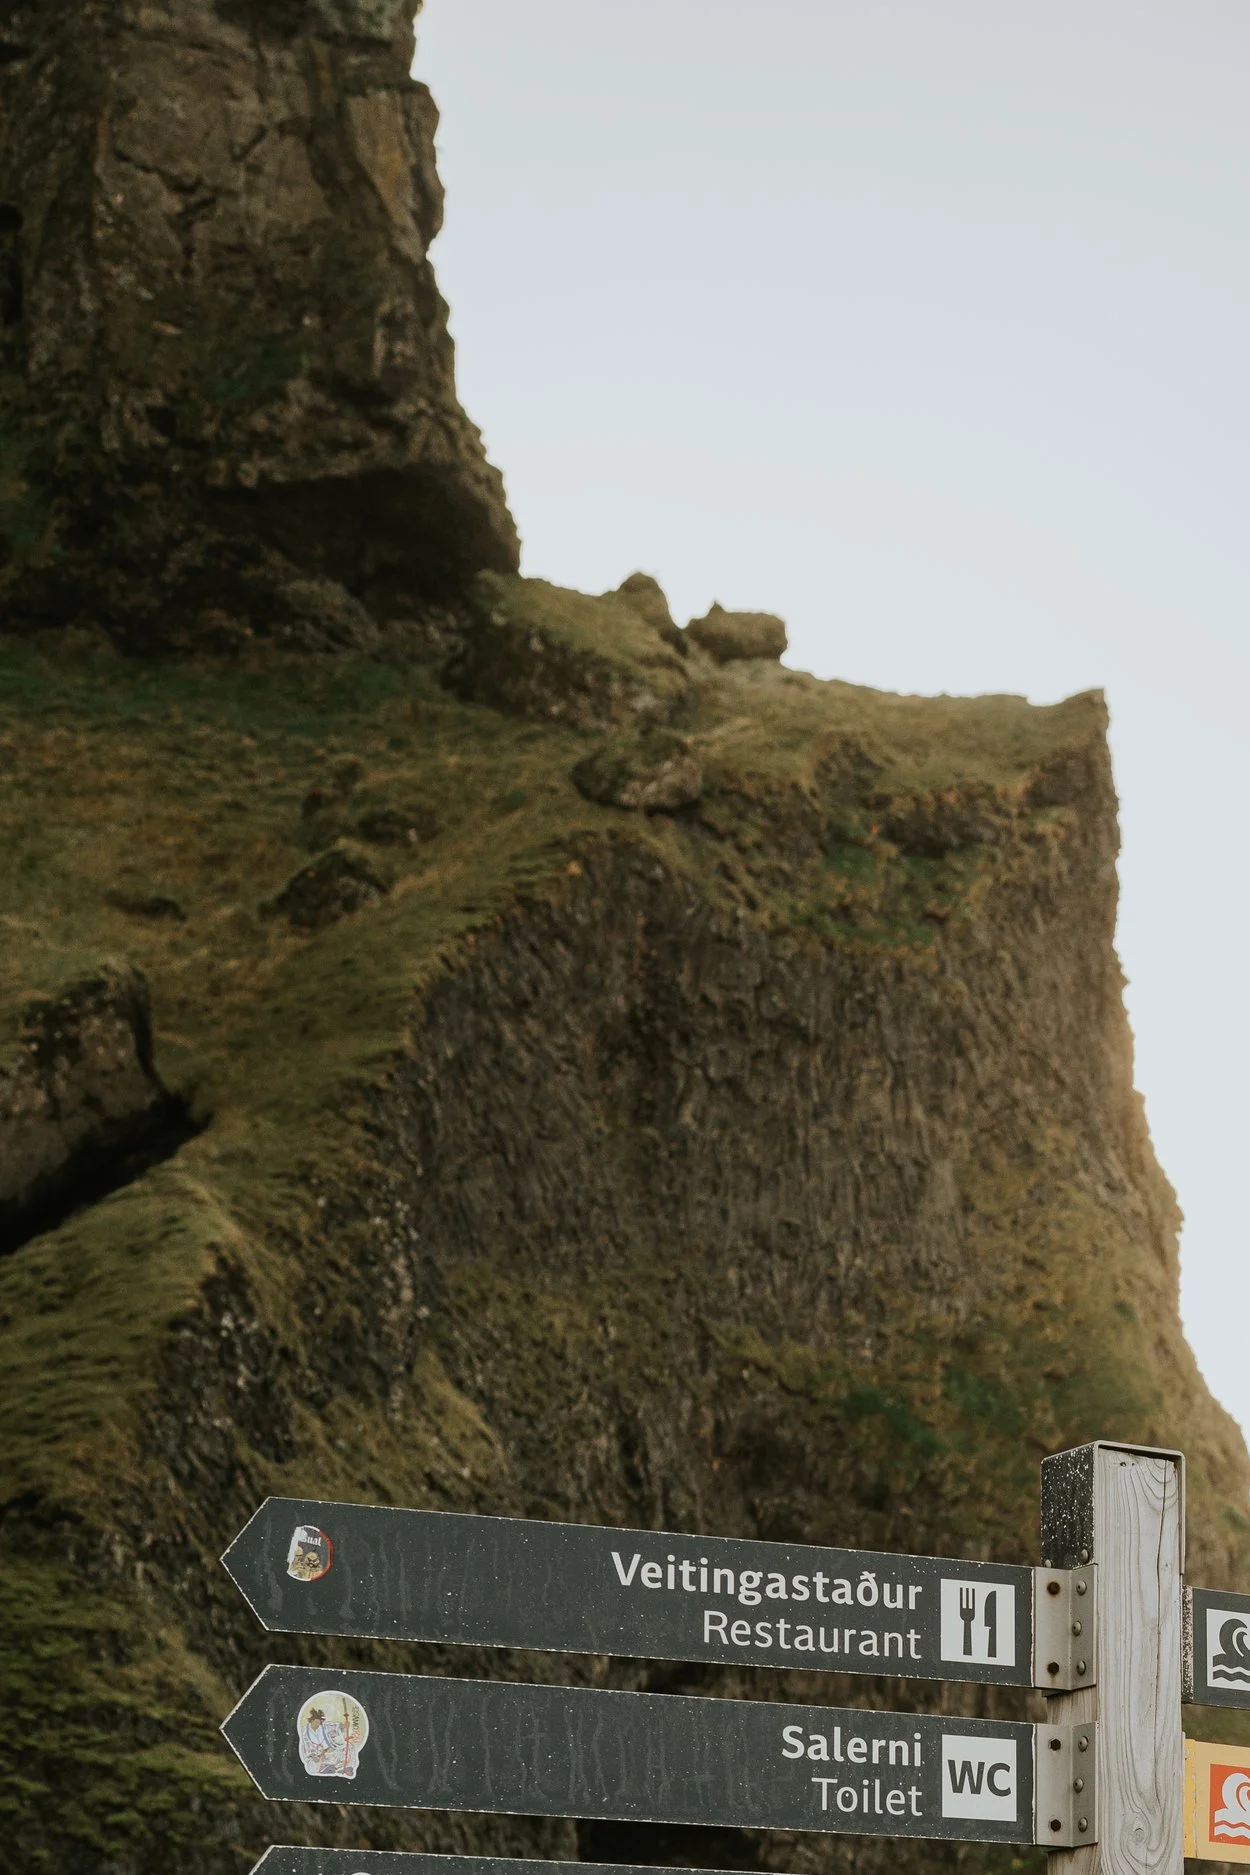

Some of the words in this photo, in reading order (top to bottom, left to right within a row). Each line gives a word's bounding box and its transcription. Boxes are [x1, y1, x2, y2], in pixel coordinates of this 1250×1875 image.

[610, 1551, 923, 1610] Veitingastaður
[703, 1610, 922, 1660] Restaurant
[781, 1725, 922, 1767] Salerni
[811, 1777, 923, 1817] Toilet
[947, 1759, 1012, 1797] WC
